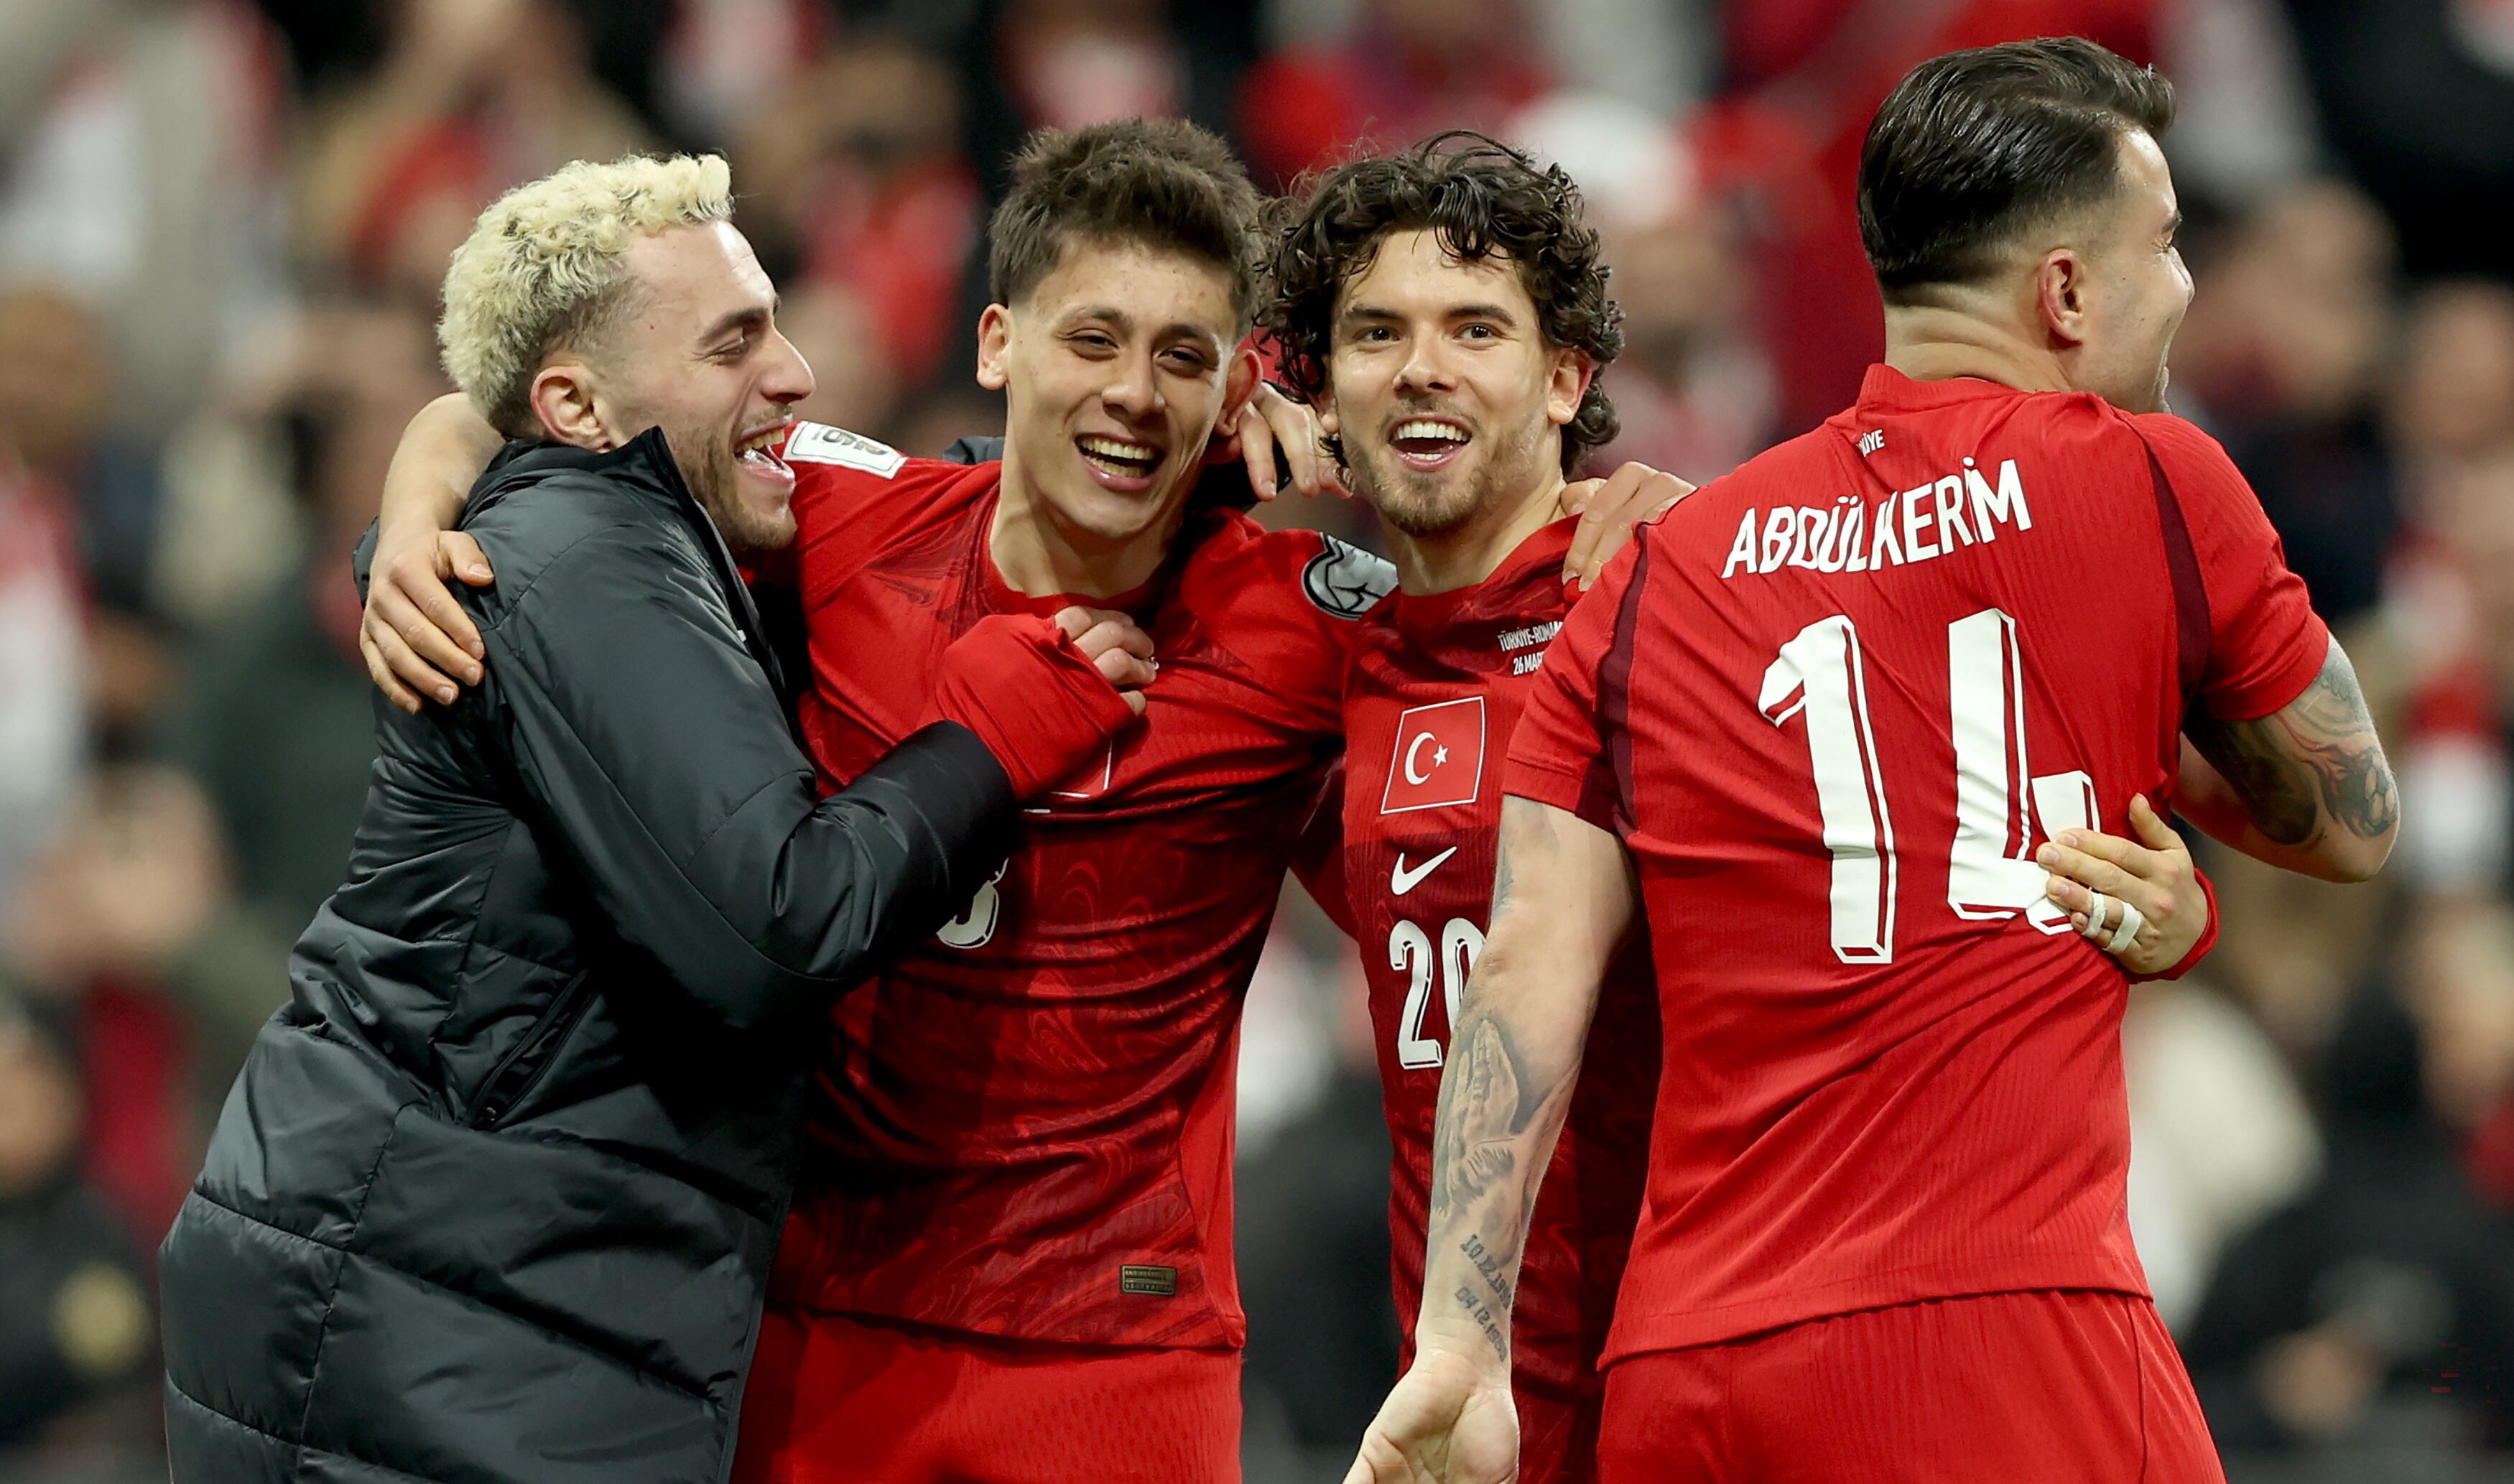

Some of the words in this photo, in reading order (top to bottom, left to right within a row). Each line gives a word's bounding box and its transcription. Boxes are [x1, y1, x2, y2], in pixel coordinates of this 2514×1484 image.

[1722, 457, 2033, 578] ABDÜLKERİM
[1513, 656, 1524, 676] 26
[1523, 651, 1544, 673] MAR
[1757, 608, 2101, 964] 14
[1389, 917, 1487, 1070] 20
